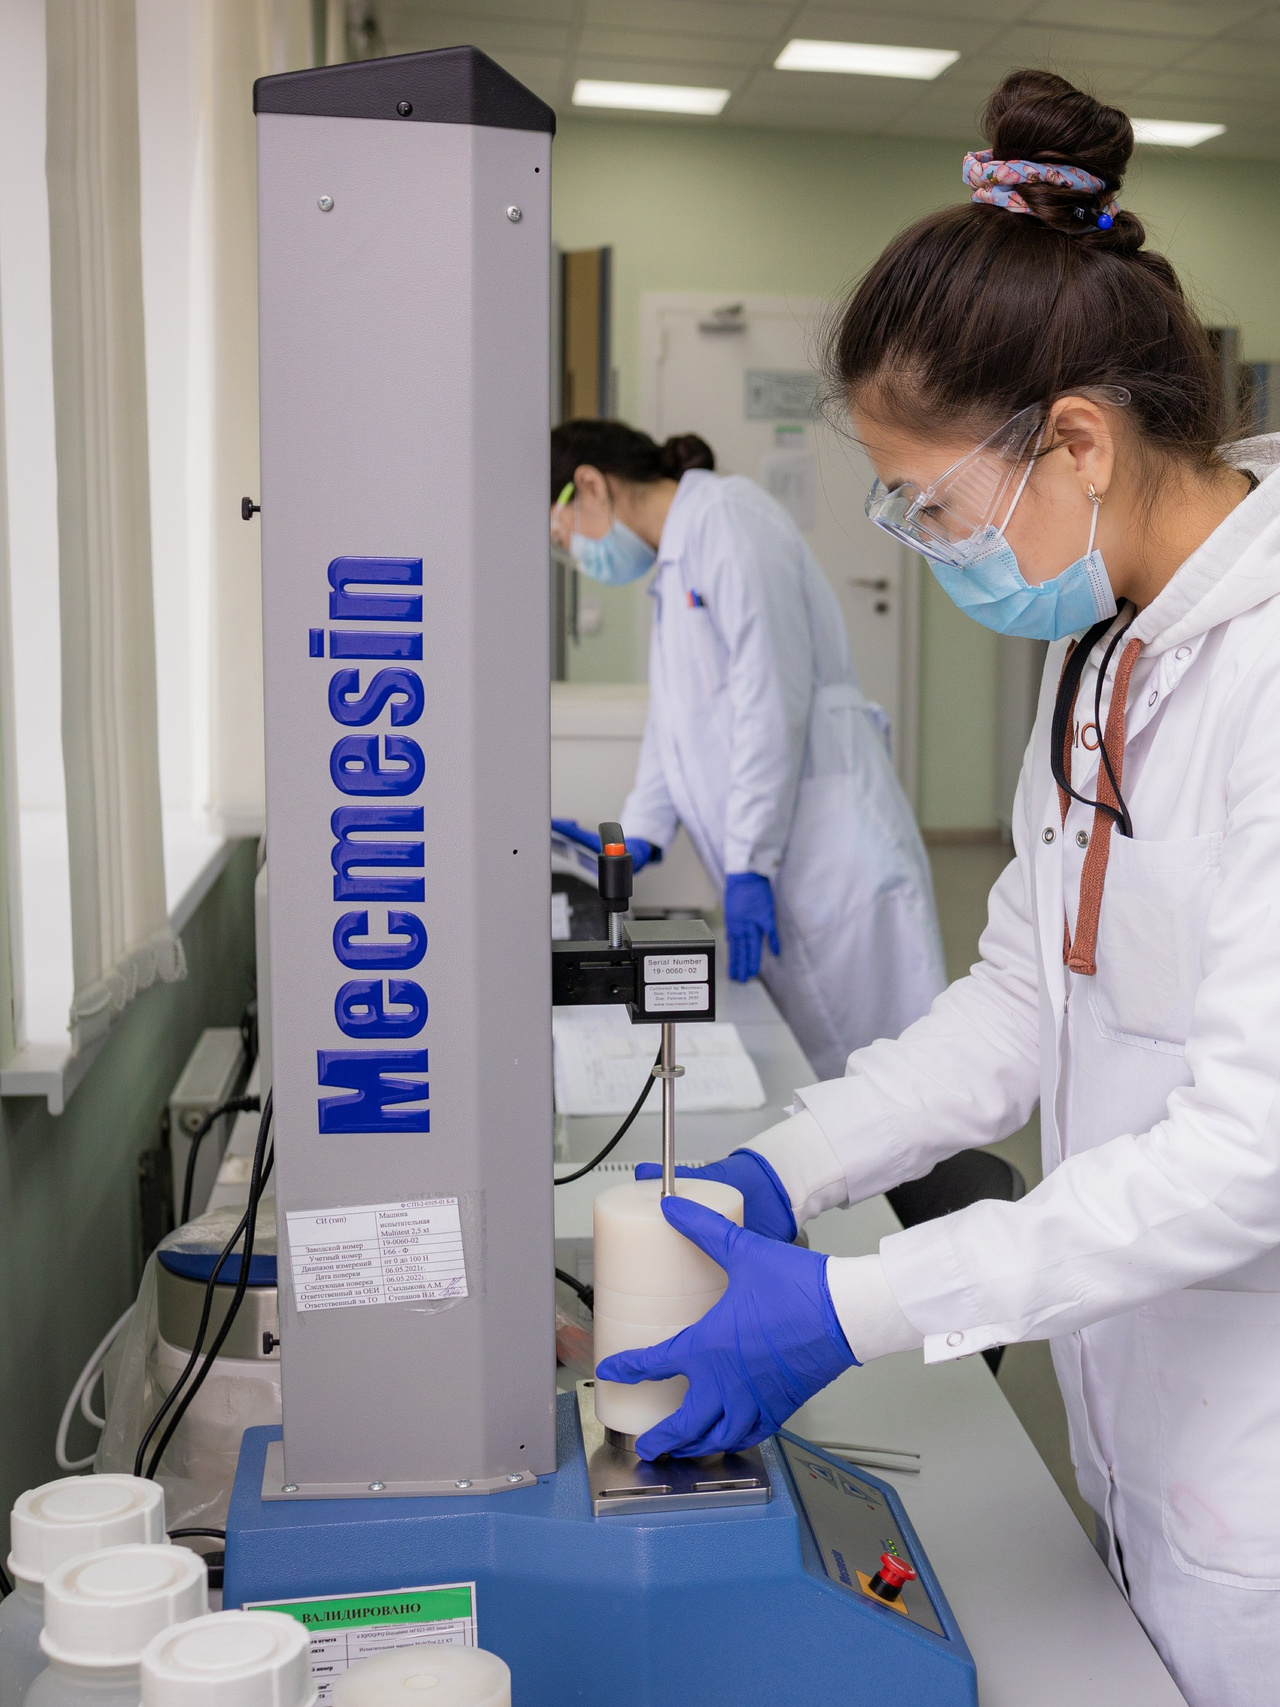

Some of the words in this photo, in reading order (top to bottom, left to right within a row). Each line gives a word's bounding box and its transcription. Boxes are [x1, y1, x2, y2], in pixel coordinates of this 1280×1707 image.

[309, 556, 430, 1134] Mecmesin
[380, 1219, 430, 1228] испытательная
[382, 1237, 419, 1246] 19-0060-02
[308, 1253, 340, 1262] Учетный
[336, 1261, 372, 1269] измерений
[385, 1265, 426, 1274] 06.05.2021г.
[387, 1284, 425, 1292] Сыздыкова
[300, 1290, 352, 1300] Ответственный
[304, 1299, 356, 1309] Ответственный
[302, 1603, 421, 1623] ВАЛИДИРОВАНО
